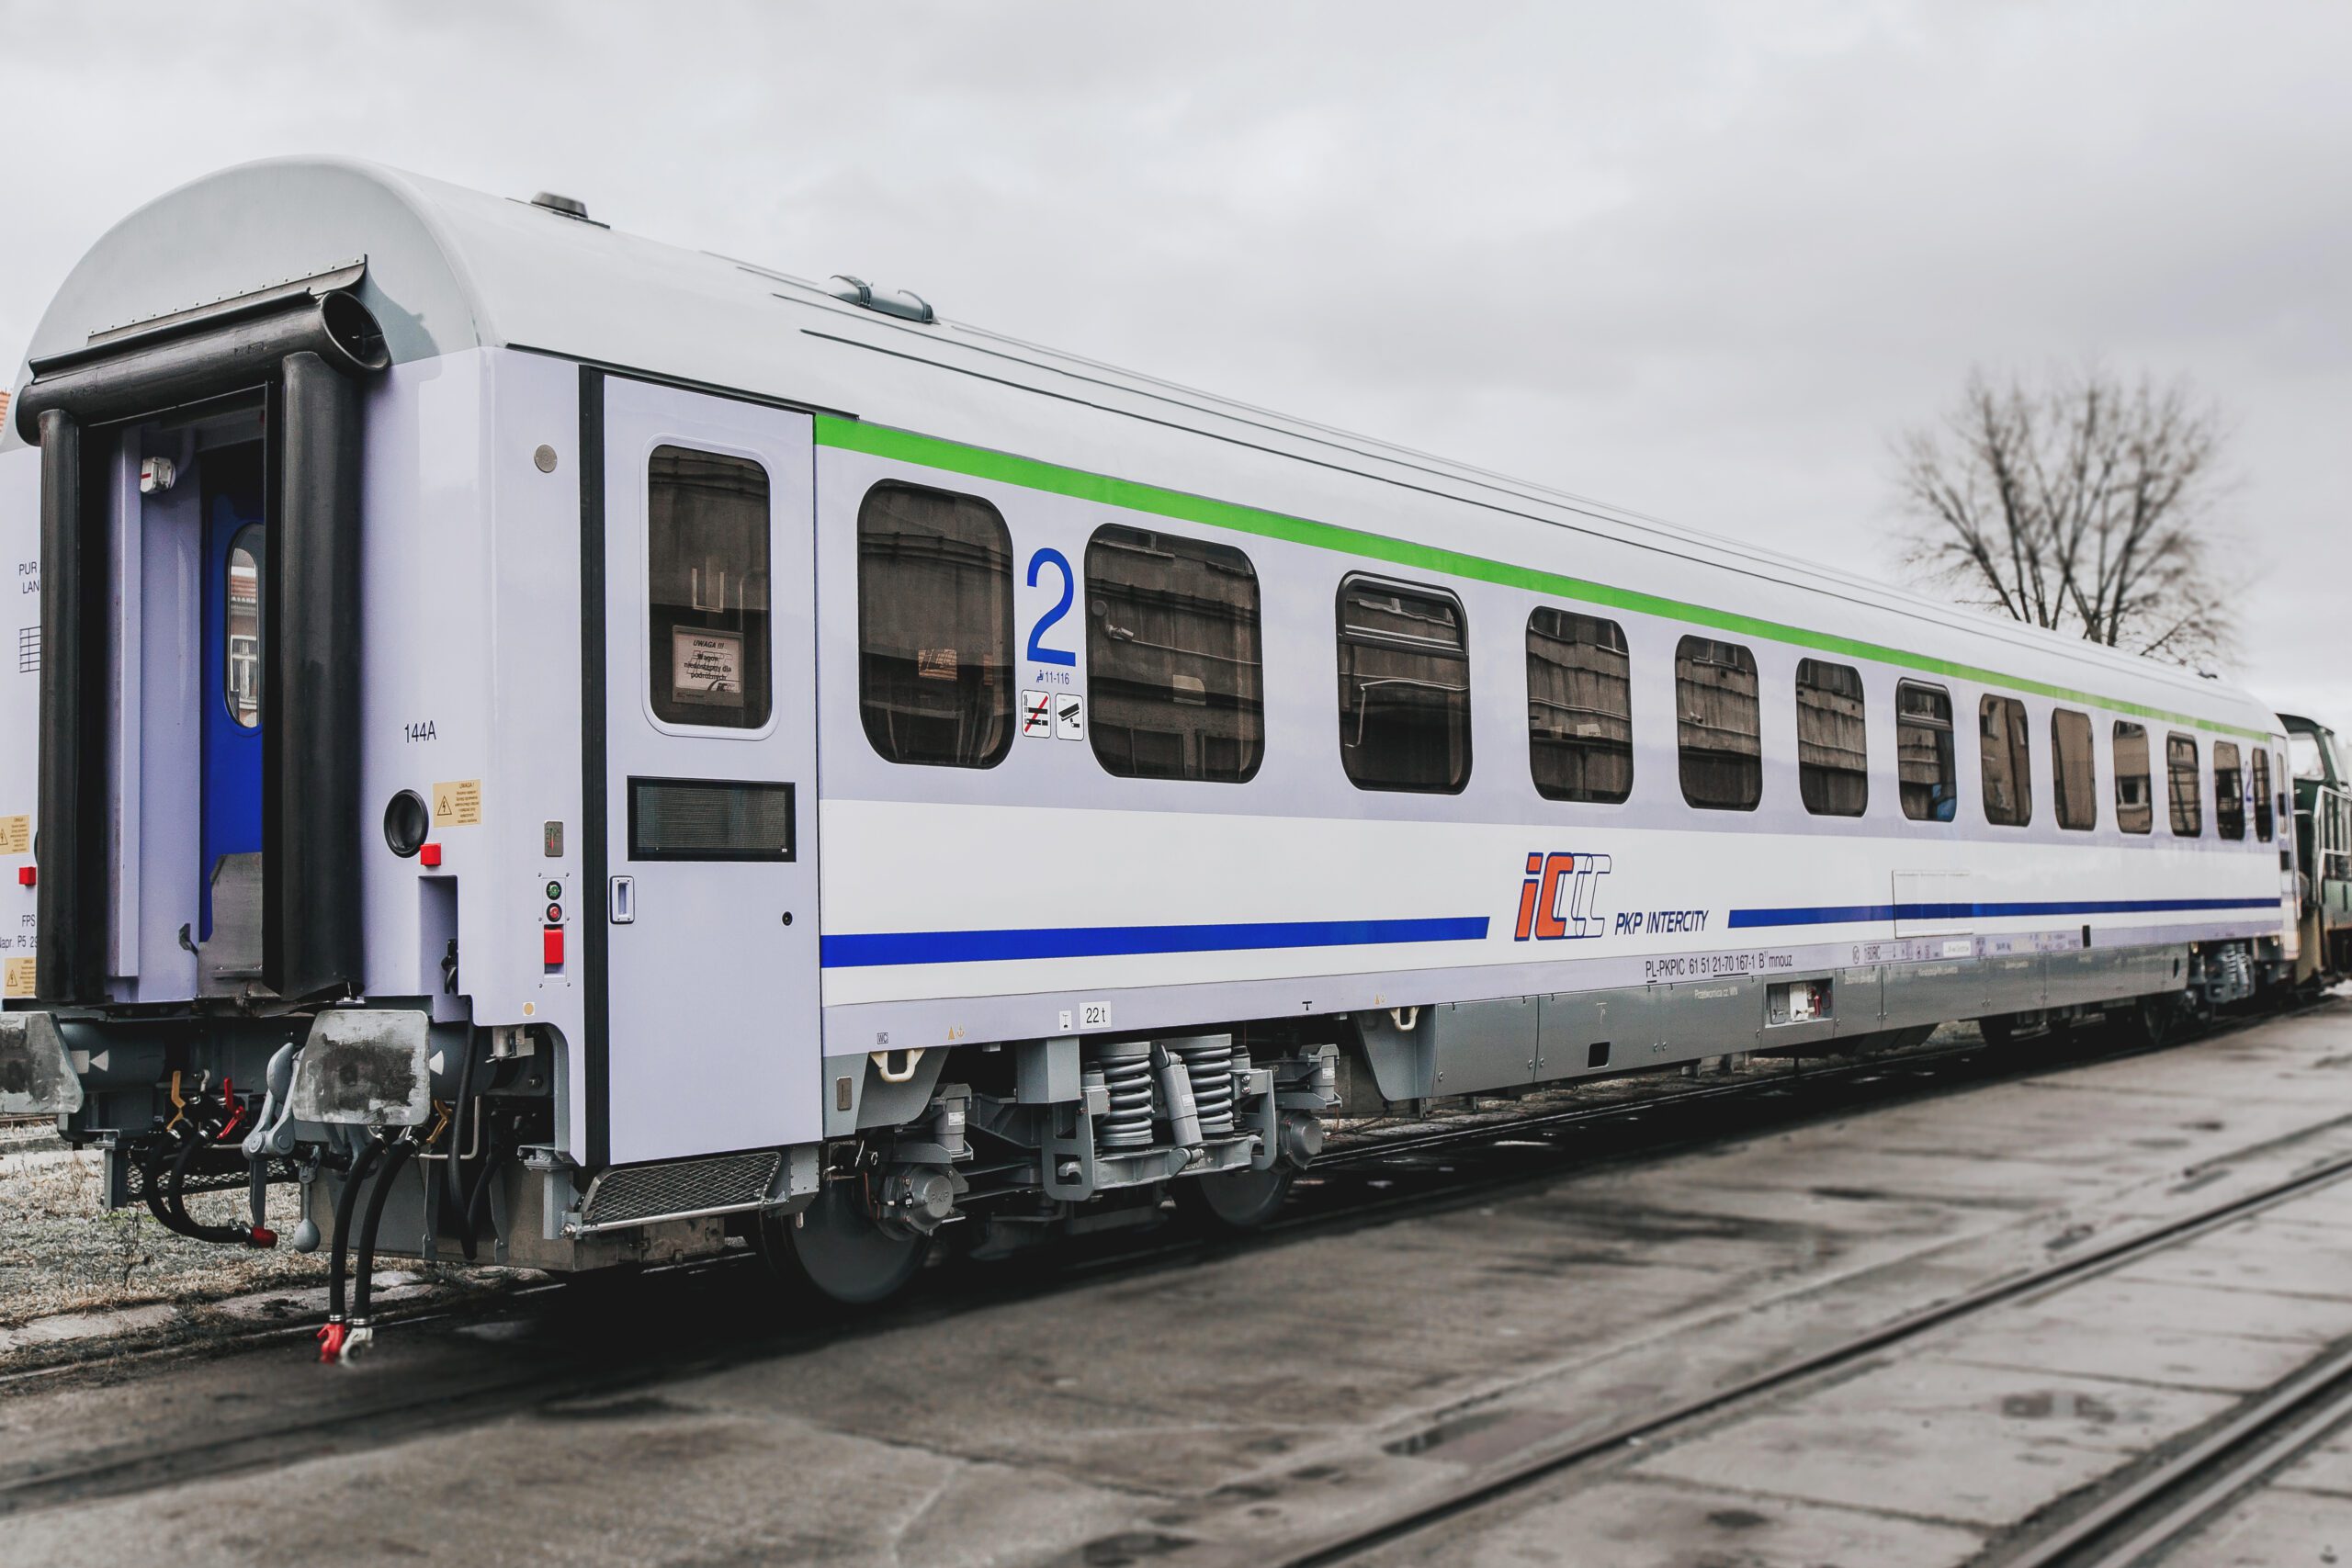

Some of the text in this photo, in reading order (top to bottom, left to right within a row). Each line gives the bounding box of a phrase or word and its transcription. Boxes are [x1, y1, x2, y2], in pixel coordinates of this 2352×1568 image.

[18, 561, 38, 576] PUR
[1026, 547, 1076, 667] 2
[693, 639, 716, 649] UWAGA
[1045, 671, 1070, 685] 11-116
[404, 720, 436, 743] 144A
[21, 914, 36, 927] FPS
[1614, 909, 1709, 935] PKP INTERCITY
[1645, 958, 1685, 977] PL-PKPIC
[1689, 957, 1698, 974] 61
[1701, 956, 1710, 974] 51
[1713, 955, 1734, 972] 21-70
[1736, 953, 1755, 970] 167-1
[1086, 1007, 1105, 1023] 22 t
